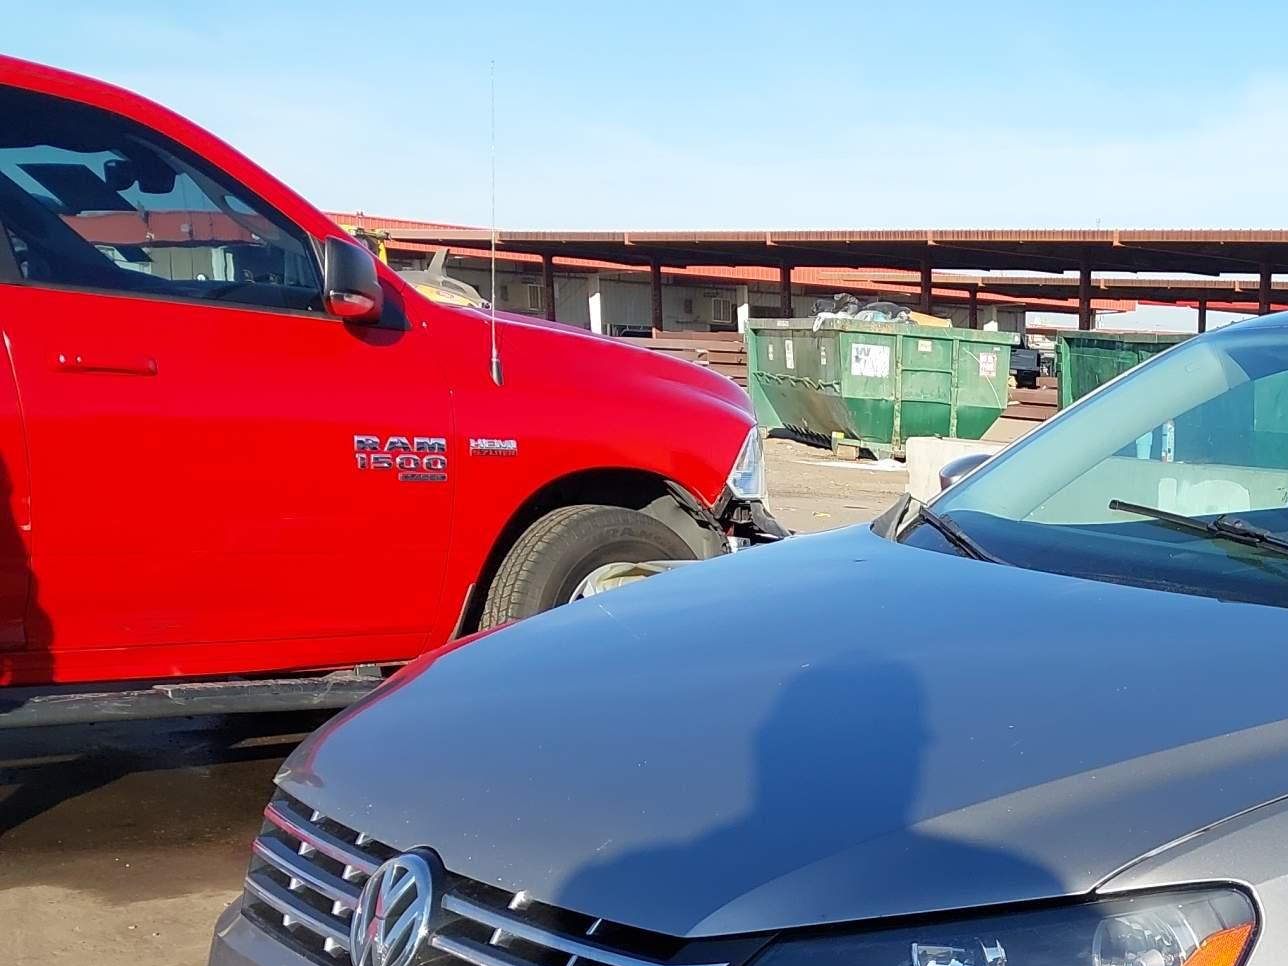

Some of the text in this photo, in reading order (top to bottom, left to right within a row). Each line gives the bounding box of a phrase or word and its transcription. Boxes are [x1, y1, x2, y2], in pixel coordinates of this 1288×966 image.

[353, 434, 446, 453] RAM
[469, 438, 517, 449] HEMI
[355, 453, 447, 471] 1500
